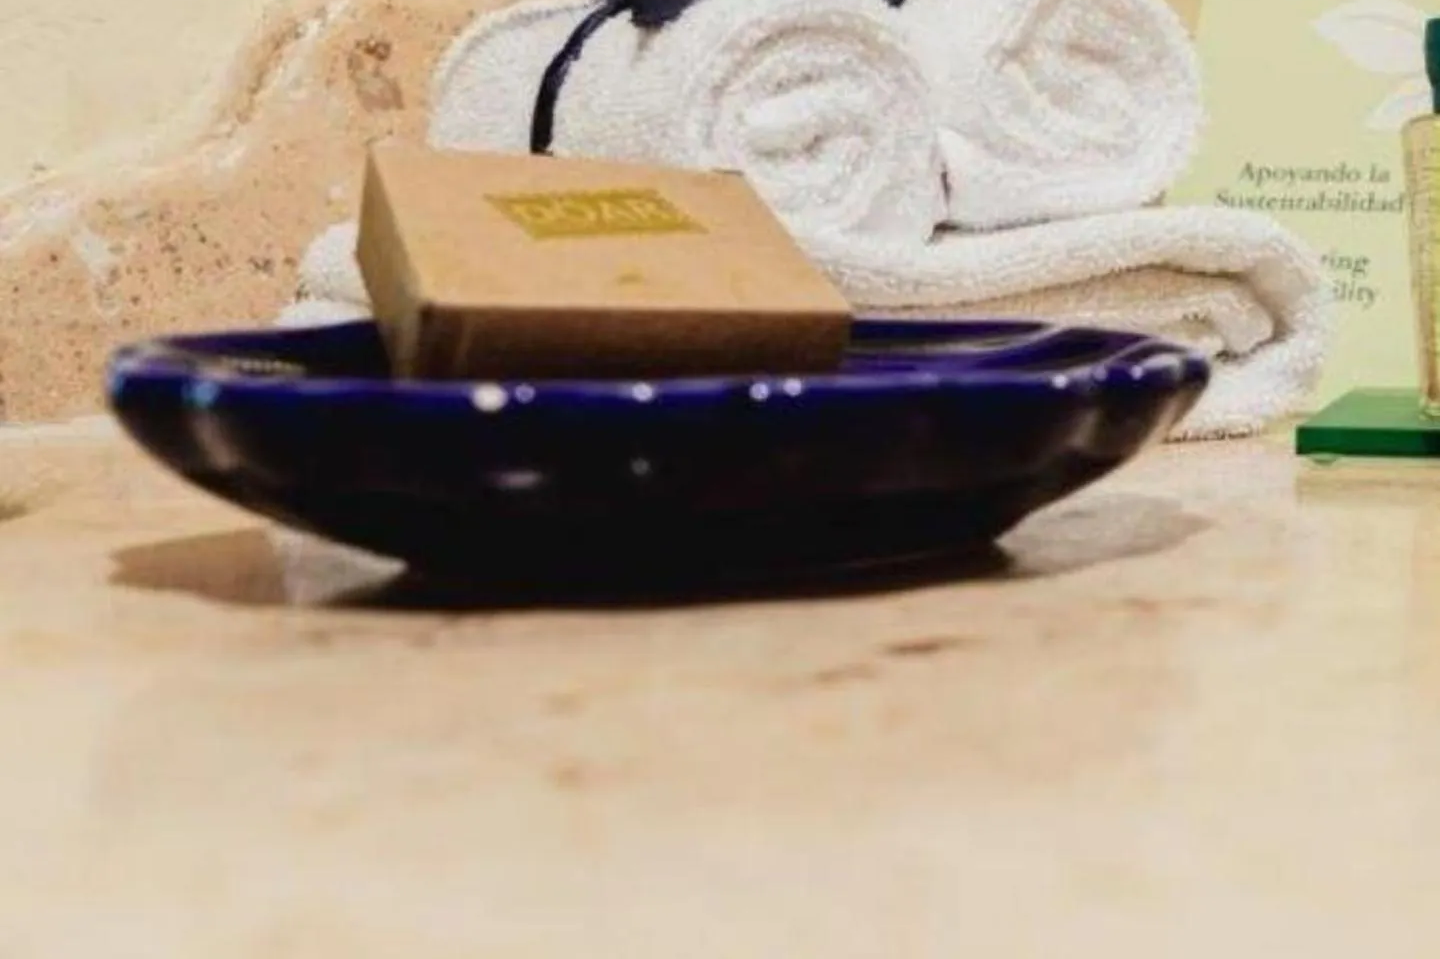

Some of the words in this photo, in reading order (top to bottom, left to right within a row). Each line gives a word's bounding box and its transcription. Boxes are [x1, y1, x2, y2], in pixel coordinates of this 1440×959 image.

[1239, 161, 1361, 187] Apoyando
[1368, 162, 1391, 183] la
[1214, 190, 1404, 212] Sustentabilidad
